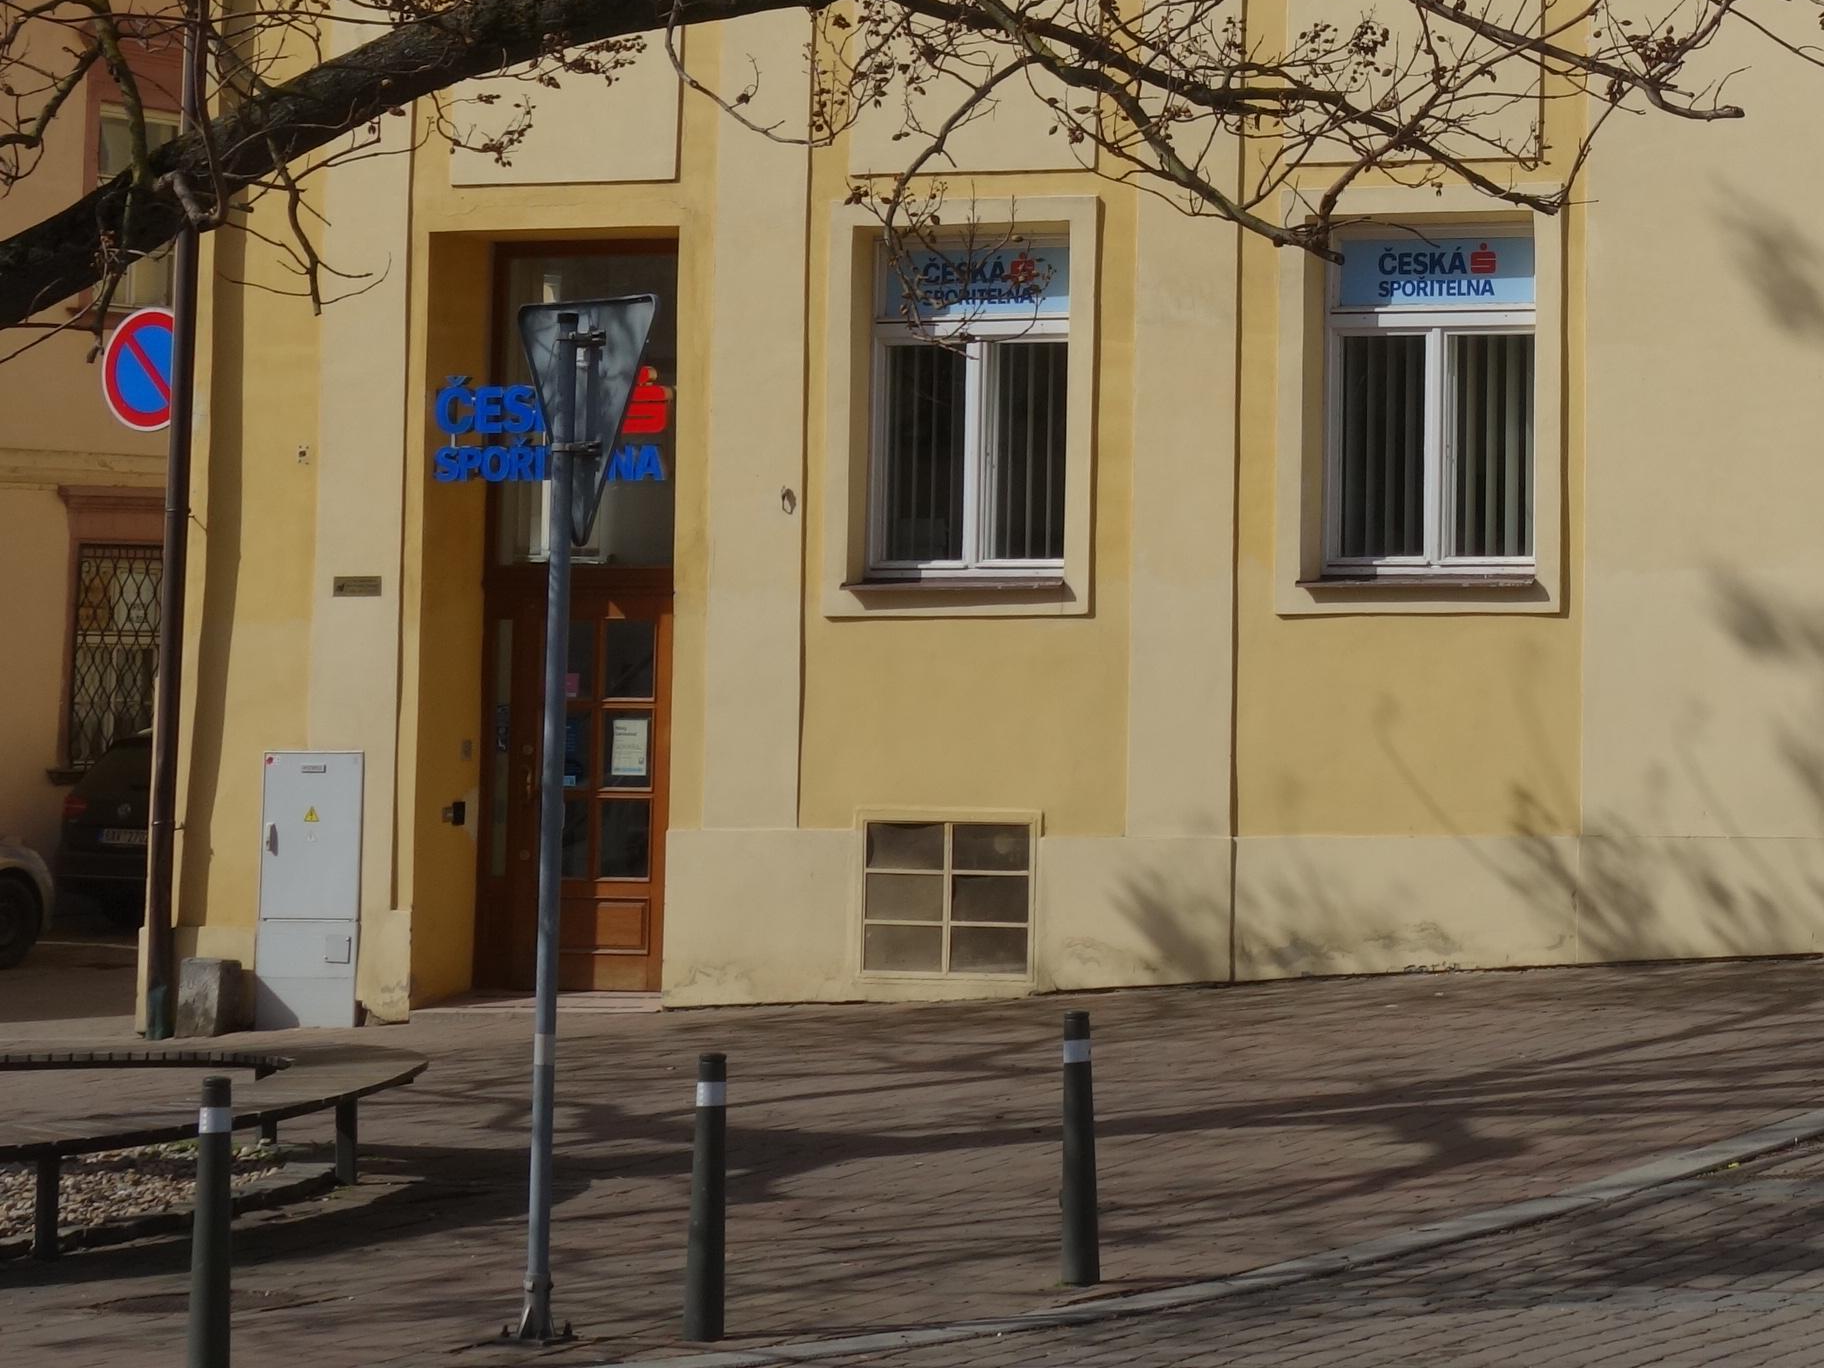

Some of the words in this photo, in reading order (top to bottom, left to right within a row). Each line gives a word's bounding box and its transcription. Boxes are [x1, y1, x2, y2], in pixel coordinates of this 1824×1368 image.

[1378, 246, 1467, 275] ČESKÁ
[1378, 275, 1495, 297] SPOŘITELNA
[434, 376, 549, 434] ČES
[434, 437, 667, 482] SPOŘINA
